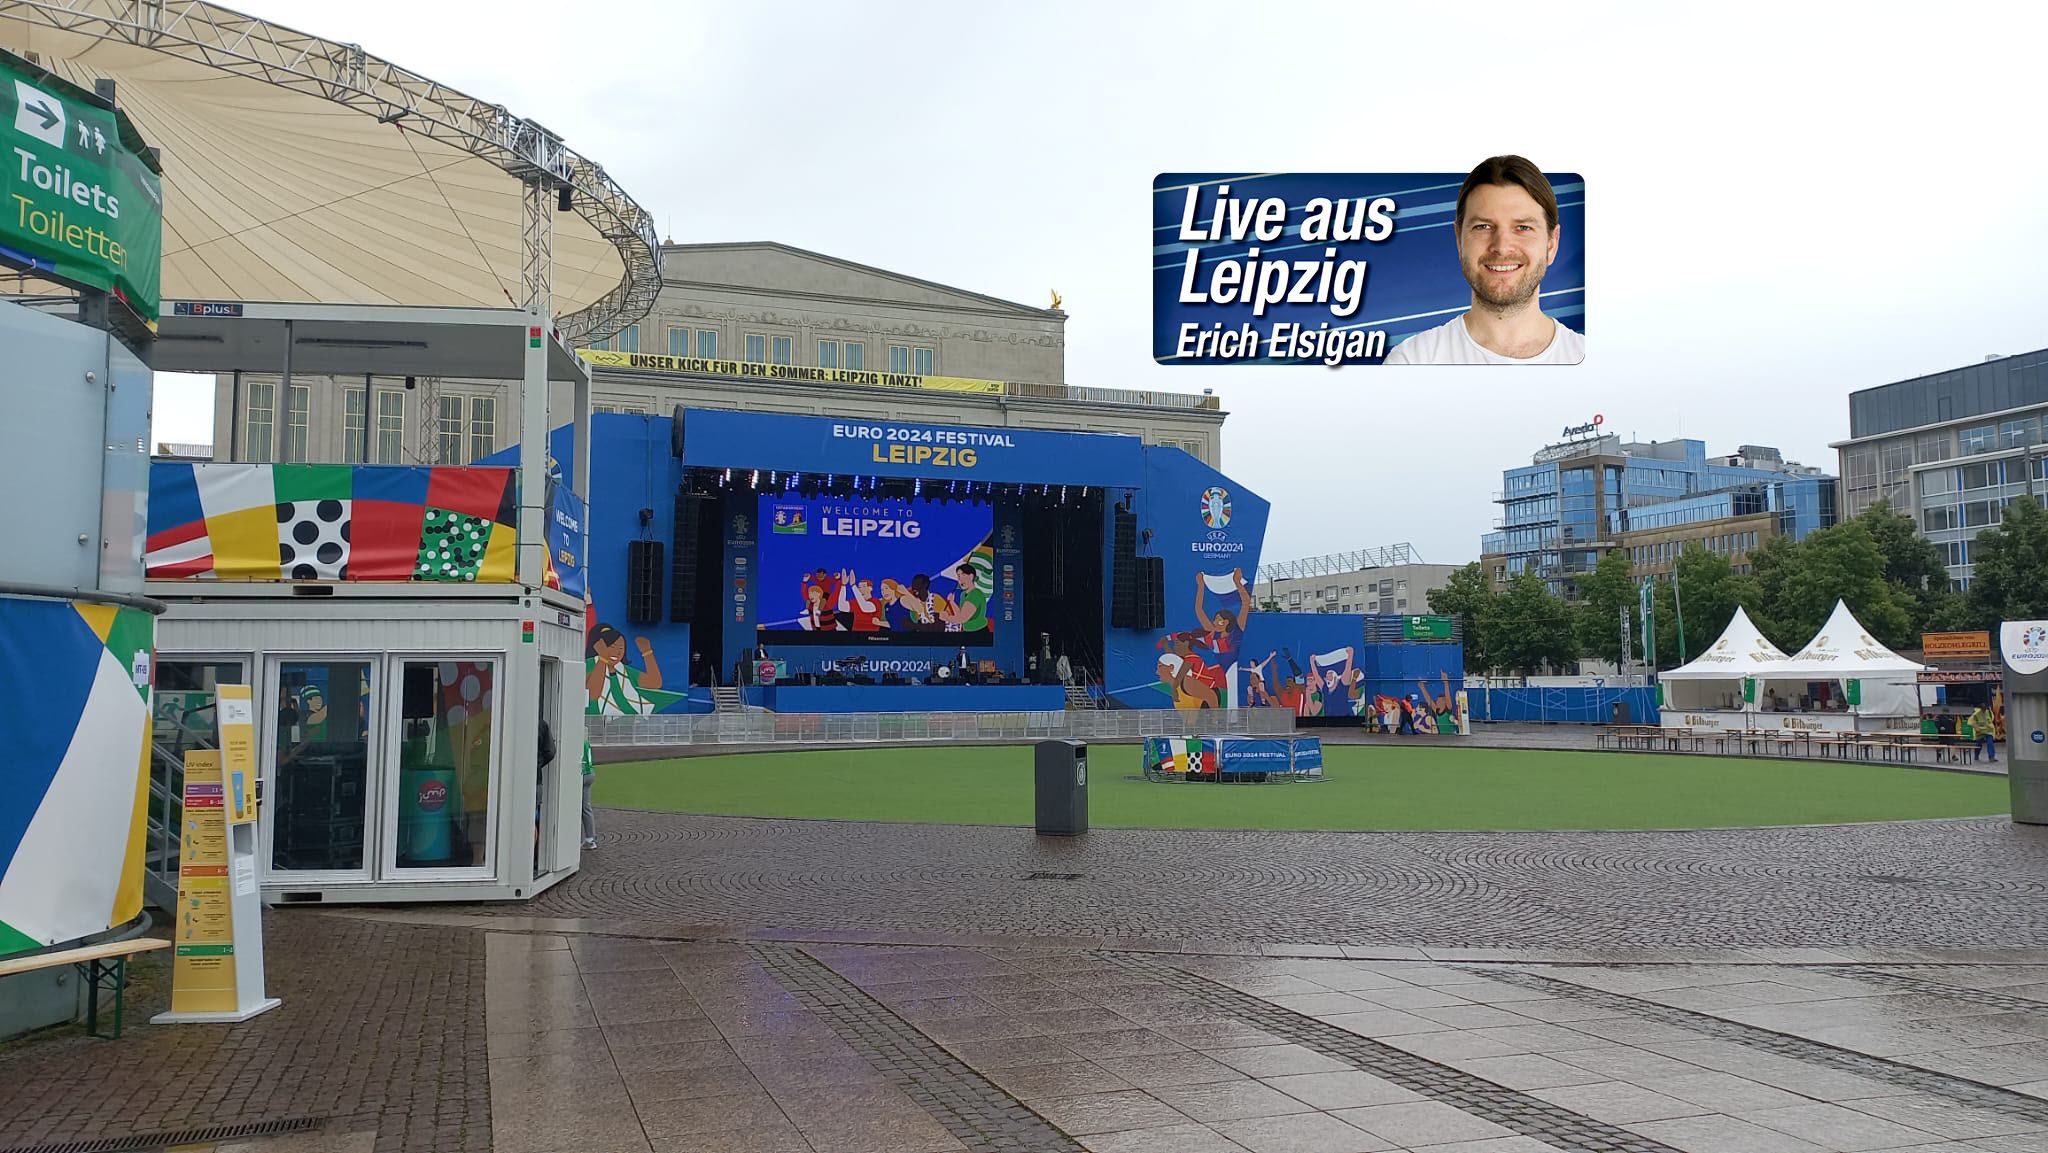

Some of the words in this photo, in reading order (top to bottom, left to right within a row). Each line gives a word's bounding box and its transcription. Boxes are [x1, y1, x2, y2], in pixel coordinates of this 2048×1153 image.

[14, 147, 119, 219] Toilets
[11, 193, 128, 273] Toiletten
[630, 354, 674, 369] UNSER
[678, 358, 709, 372] KICK
[741, 363, 766, 376] DEN
[770, 366, 829, 381] SOMMER:
[832, 369, 878, 385] LEIPZIG
[882, 374, 922, 388] TANZT!
[833, 424, 883, 440] EURO
[886, 428, 933, 443] 2024
[935, 431, 1015, 447] FESTIVAL
[1562, 422, 1595, 437] Avedo
[872, 443, 978, 468] LEIPZIG
[555, 507, 579, 533] WELCOME
[822, 505, 889, 517] WELCOME
[897, 508, 913, 517] TO
[822, 517, 921, 538] LEIPZIG
[562, 532, 570, 546] TO
[1191, 542, 1244, 552] EURO2024
[558, 547, 576, 568] LEIPZIG
[418, 787, 446, 804] jump
